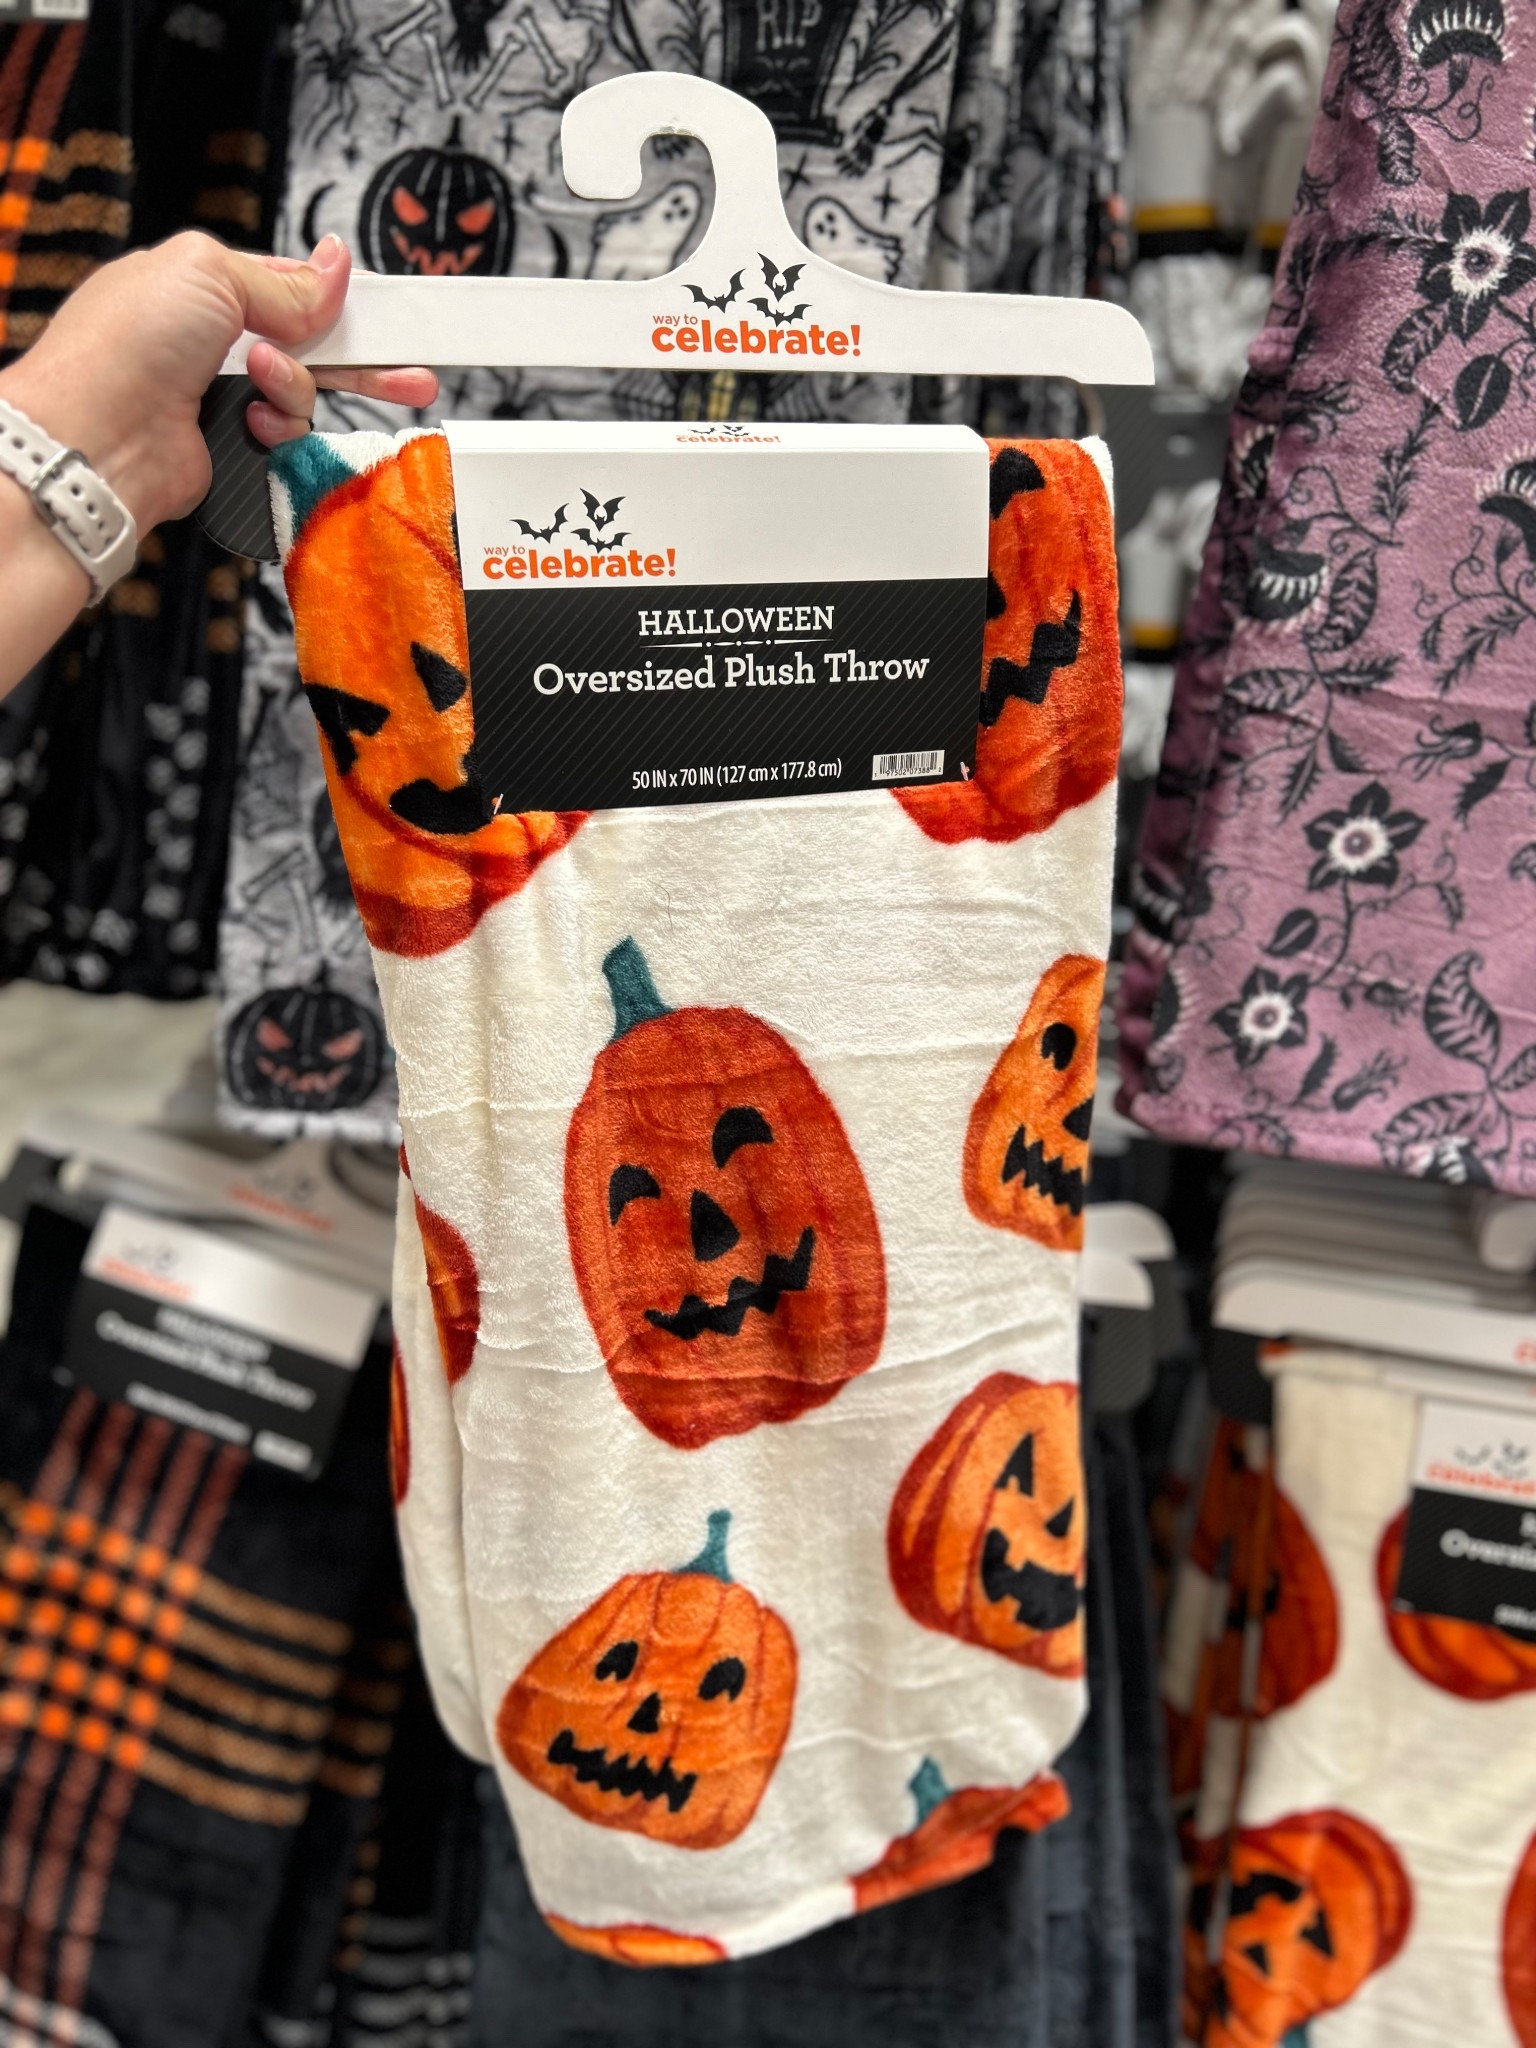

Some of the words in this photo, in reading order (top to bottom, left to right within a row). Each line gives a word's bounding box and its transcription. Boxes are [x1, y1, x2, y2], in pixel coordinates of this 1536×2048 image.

[652, 315, 681, 326] way
[684, 314, 698, 325] to
[652, 320, 861, 357] celebrate!
[676, 435, 781, 443] celebrate!
[483, 545, 509, 557] way
[512, 544, 526, 555] to
[483, 548, 676, 580] celebrate!
[638, 605, 835, 636] HALLOWEEN
[533, 654, 716, 695] Oversized
[724, 651, 816, 688] Plush
[824, 649, 930, 683] Throw
[632, 771, 650, 789] 50
[652, 769, 667, 788] IN
[669, 773, 678, 787] x
[680, 768, 697, 787] 70
[700, 767, 714, 785] IN
[716, 765, 746, 787] (127
[748, 769, 768, 782] cm
[771, 766, 779, 781] x
[781, 760, 816, 779] 177.8
[818, 757, 842, 779] cm)
[886, 769, 907, 777] 97502
[909, 767, 930, 775] 07388
